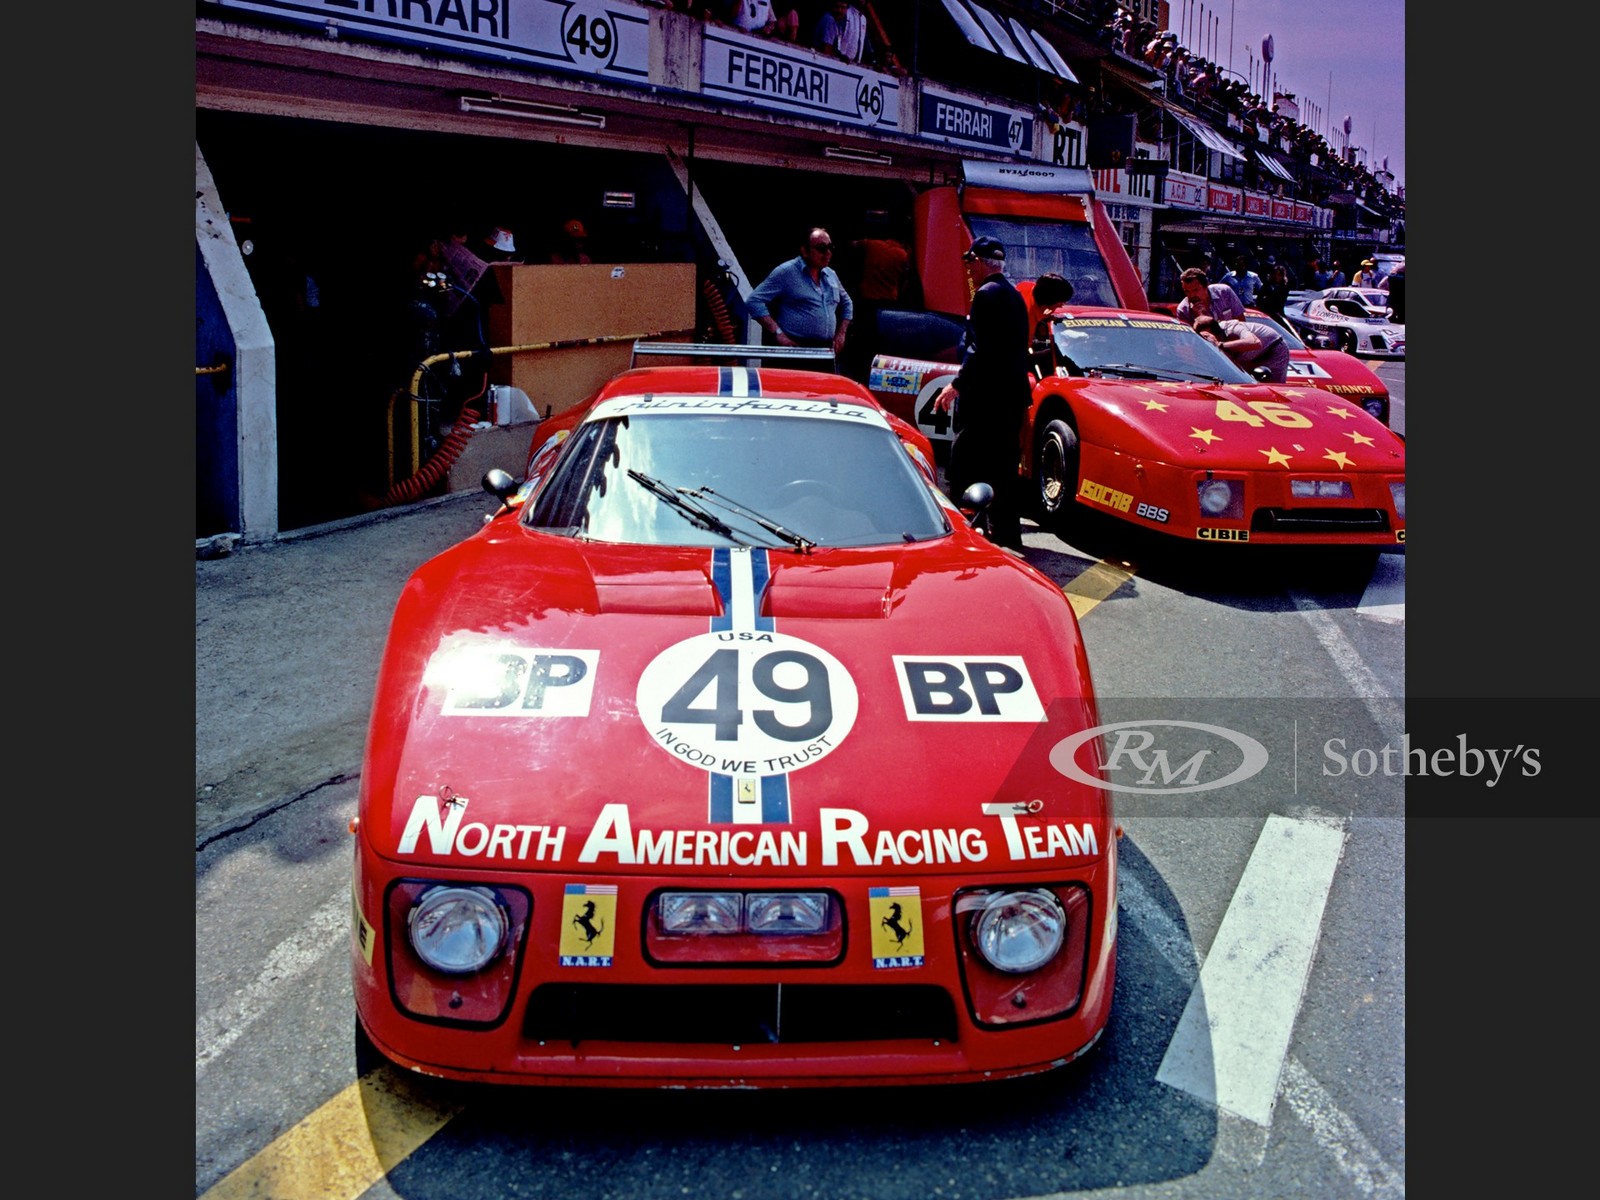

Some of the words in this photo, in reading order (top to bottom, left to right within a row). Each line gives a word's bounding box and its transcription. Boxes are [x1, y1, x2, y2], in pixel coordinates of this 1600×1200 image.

[566, 14, 612, 59] 49
[728, 49, 829, 104] FERRARI
[858, 83, 882, 116] 46
[936, 103, 993, 139] FERRARI
[1008, 120, 1023, 144] 47
[998, 168, 1056, 178] GOODYEAR
[1062, 319, 1127, 328] EUROPEAN
[1325, 384, 1375, 395] FRANCE
[613, 400, 868, 420] pininfarina
[917, 387, 952, 436] 4
[1215, 400, 1314, 429] 46
[1080, 479, 1134, 513] ISOCAB
[1136, 502, 1169, 522] BBS
[1197, 528, 1249, 541] CIBIE
[718, 632, 773, 643] USA
[452, 654, 588, 709] BP
[661, 648, 833, 742] 49
[903, 661, 1024, 716] BP
[655, 727, 677, 745] IN
[674, 741, 716, 767] GOD
[721, 758, 757, 773] WE
[763, 735, 833, 771] TRUST
[398, 794, 567, 856] NORTH
[579, 803, 808, 866] AMERICAN
[819, 807, 989, 867] RACING
[981, 802, 1099, 861] TEAM
[562, 955, 611, 967] N.A.R.T.
[875, 956, 923, 969] N.A.R.T.
